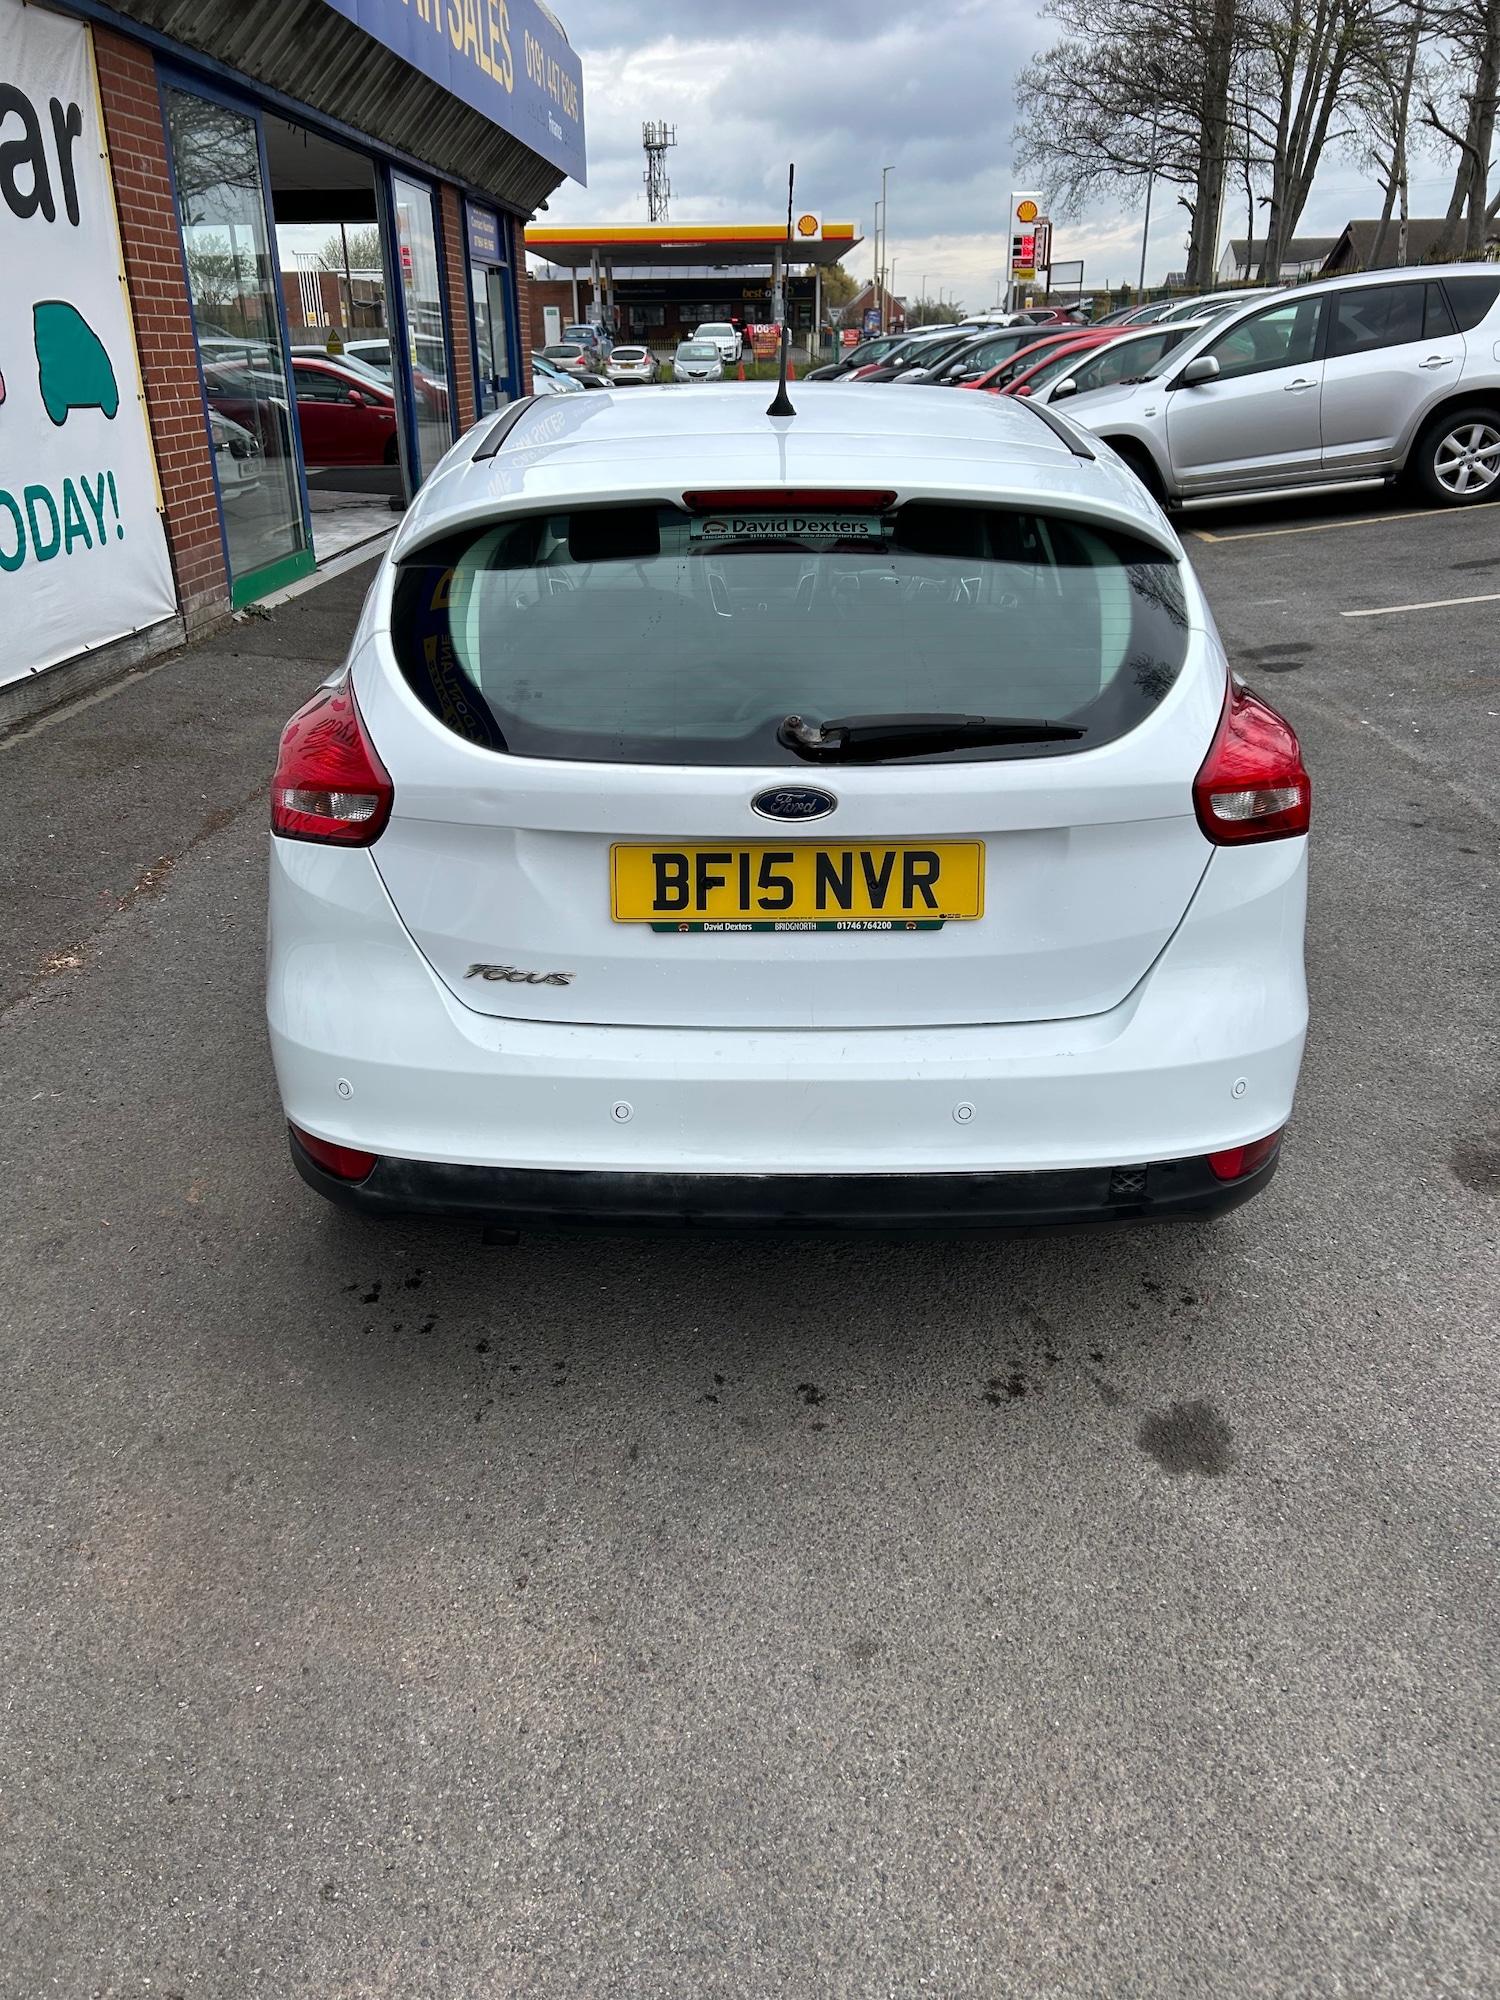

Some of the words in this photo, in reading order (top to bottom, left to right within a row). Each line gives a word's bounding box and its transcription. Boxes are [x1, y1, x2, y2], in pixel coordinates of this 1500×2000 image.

[524, 28, 546, 92] 0191
[547, 55, 560, 105] 447
[561, 70, 579, 124] 6245
[732, 519, 788, 532] David
[793, 519, 869, 533] Dexters
[770, 793, 817, 813] Ford
[652, 852, 794, 911] BF15
[815, 851, 940, 910] NVR
[704, 923, 723, 931] David
[725, 923, 752, 931] Dexters
[774, 923, 817, 931] BRIDGNORTH
[837, 922, 861, 930] 01746
[863, 921, 892, 930] 764200
